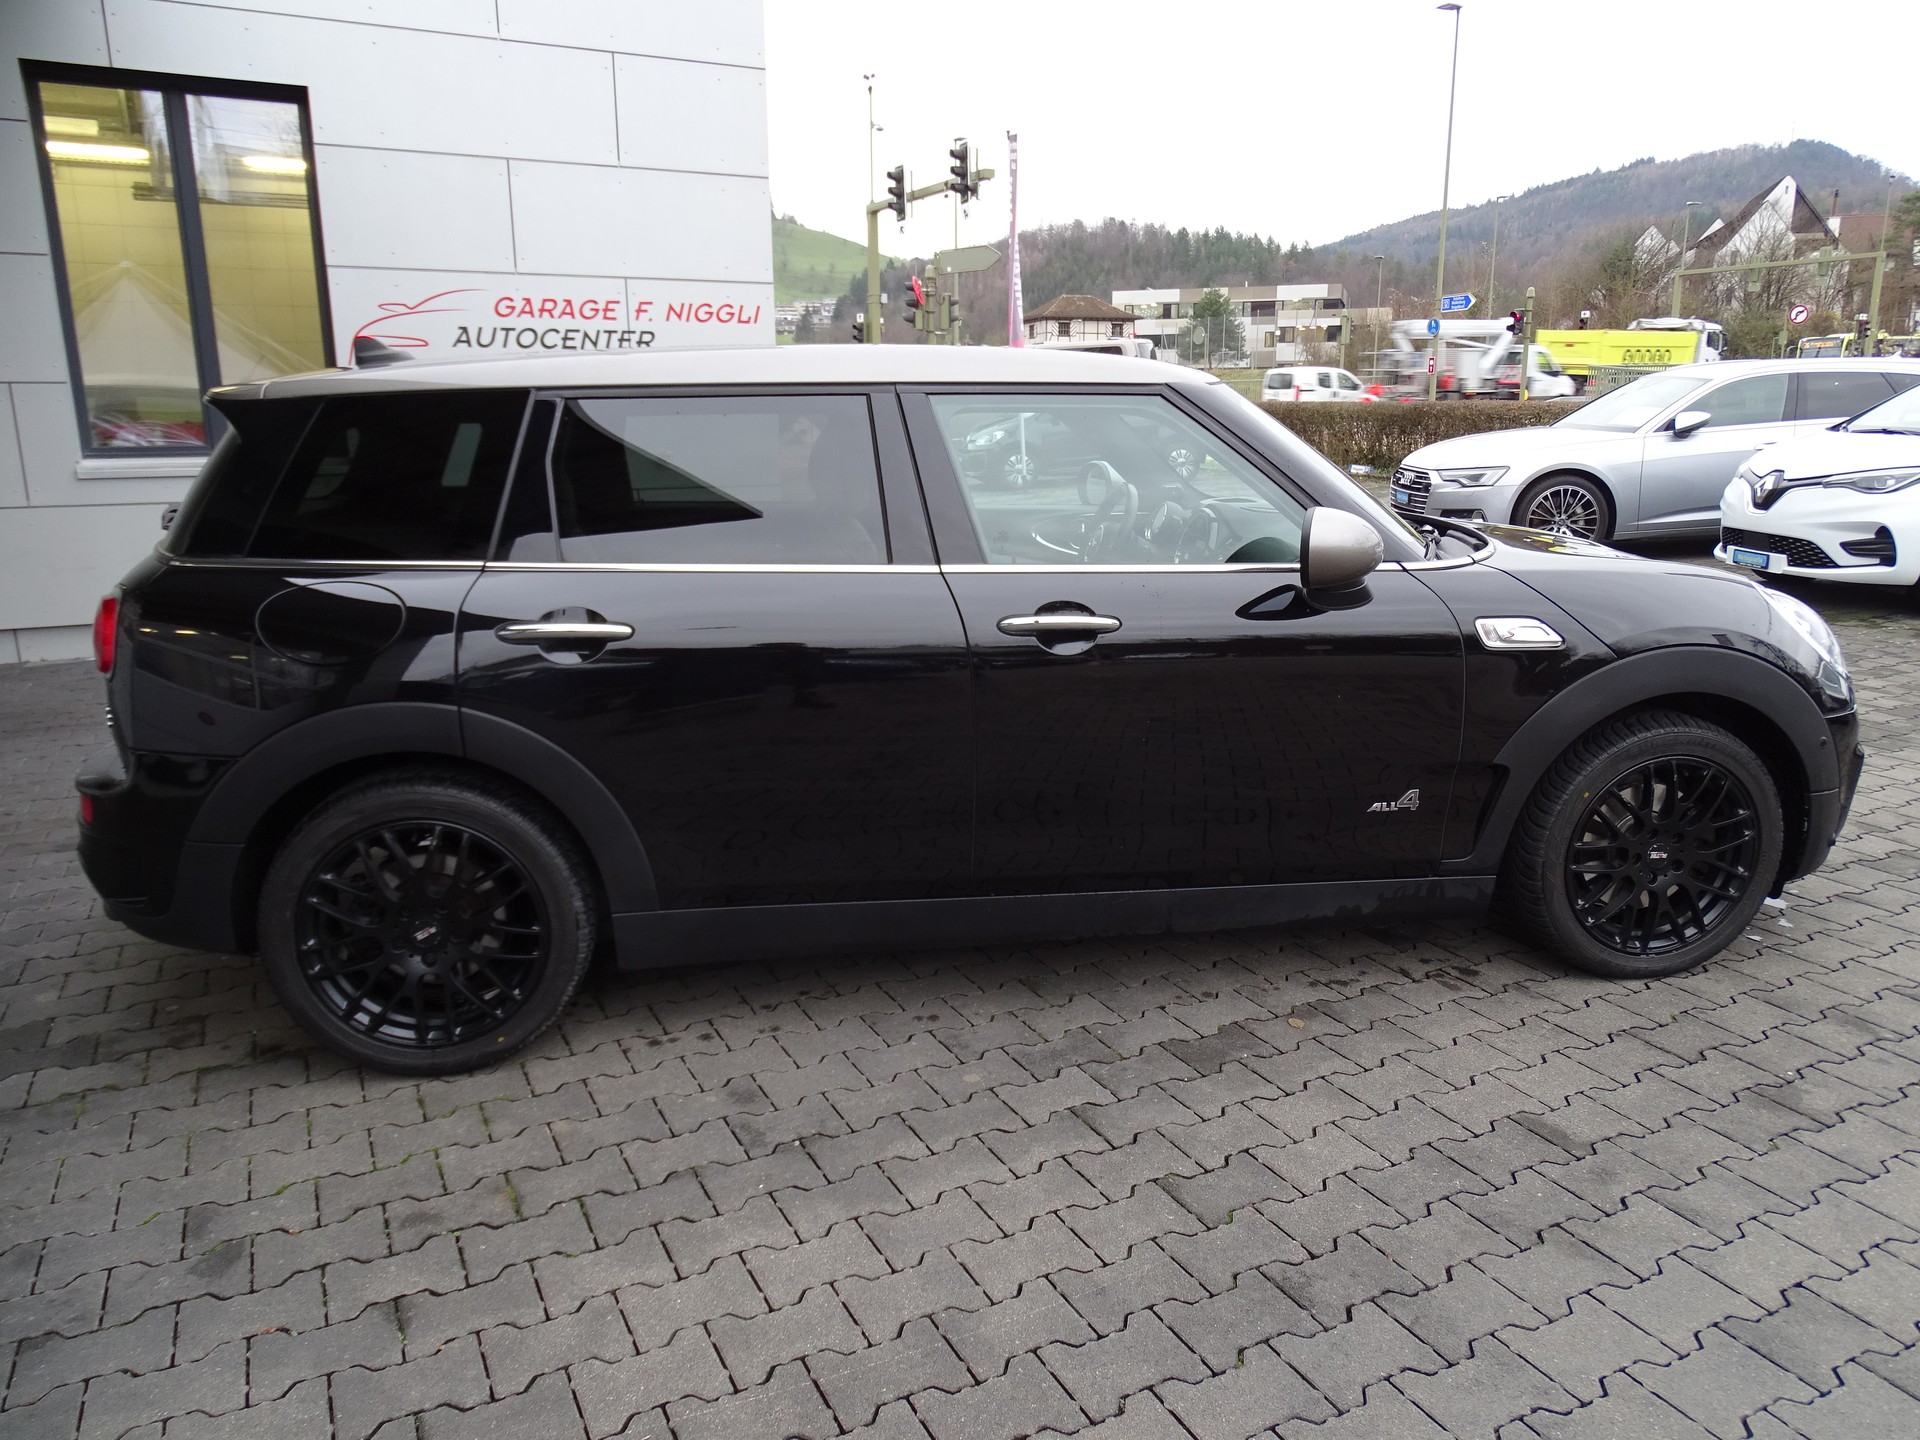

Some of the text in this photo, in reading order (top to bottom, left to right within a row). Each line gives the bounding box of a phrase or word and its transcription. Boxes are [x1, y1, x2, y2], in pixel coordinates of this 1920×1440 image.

[494, 296, 760, 325] GARAGE F. NIGGLI
[452, 326, 655, 350] AUTOCENTER
[1366, 789, 1420, 812] ALL4
